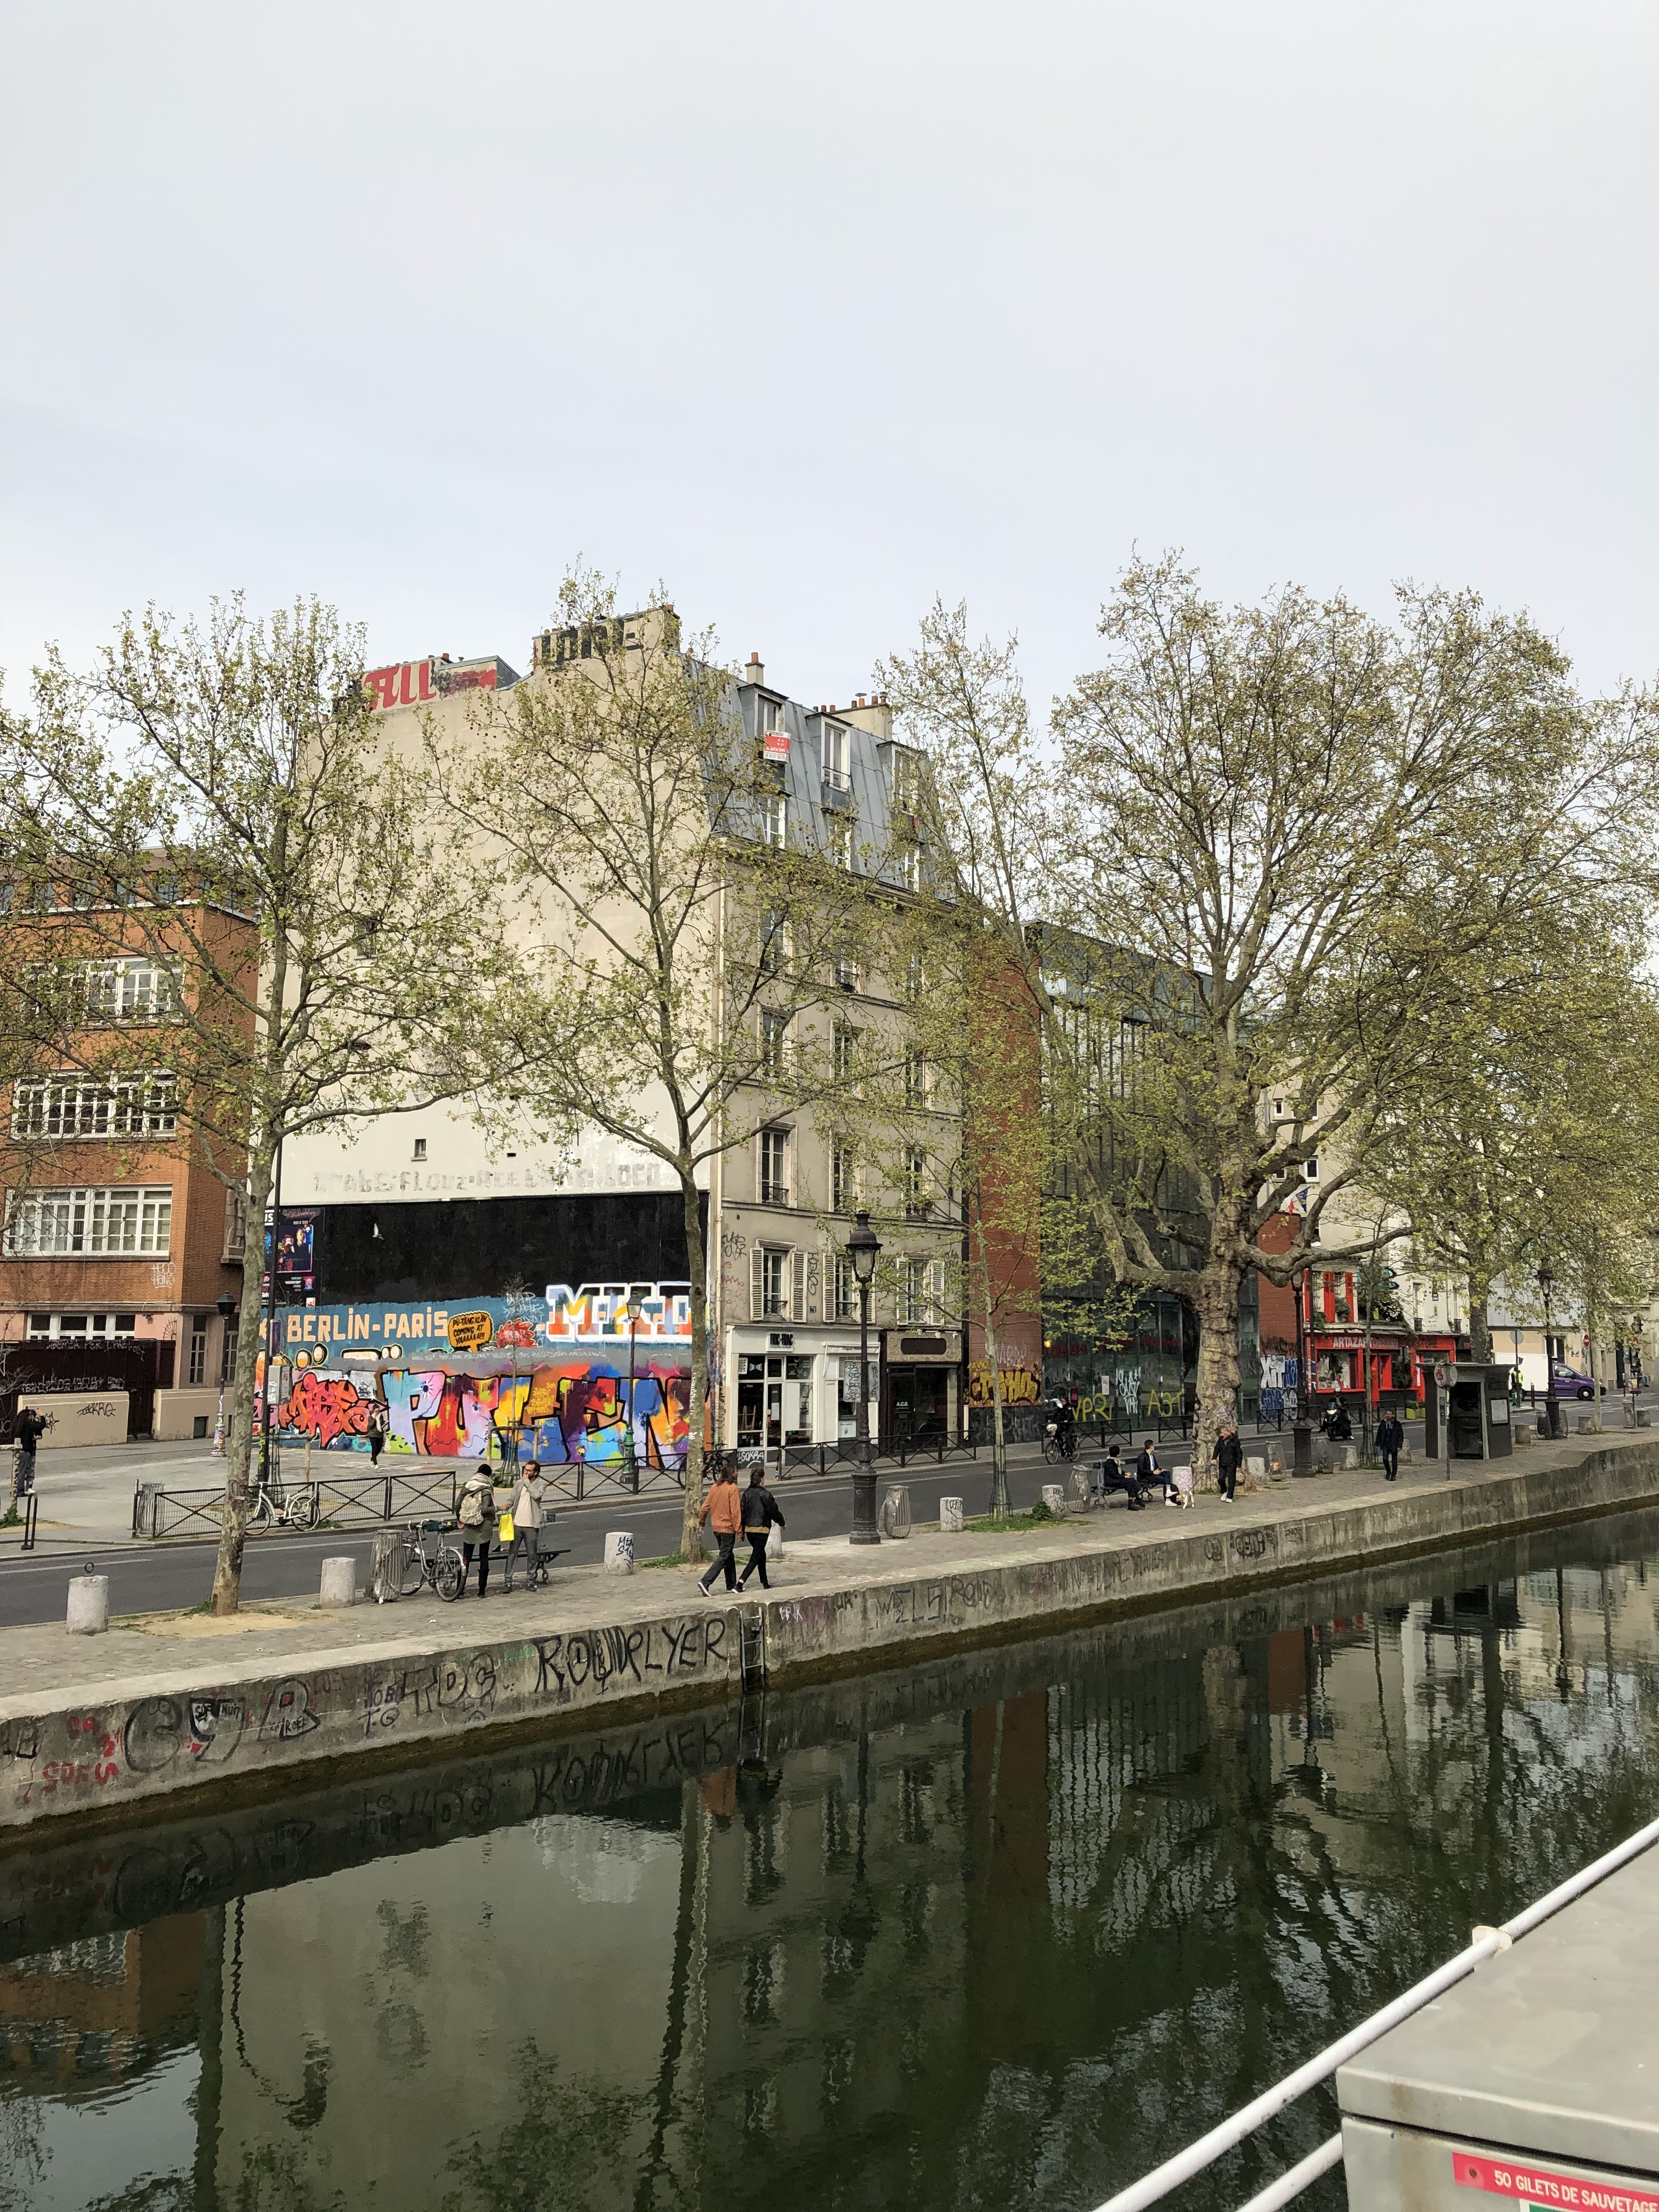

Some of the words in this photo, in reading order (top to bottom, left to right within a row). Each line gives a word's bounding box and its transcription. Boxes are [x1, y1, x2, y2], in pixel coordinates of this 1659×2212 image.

[1494, 2170, 1512, 2187] 50
[1516, 2175, 1560, 2198] GILETS
[1561, 2185, 1580, 2204] DE
[1581, 2190, 1659, 2212] SAUVETAGE
